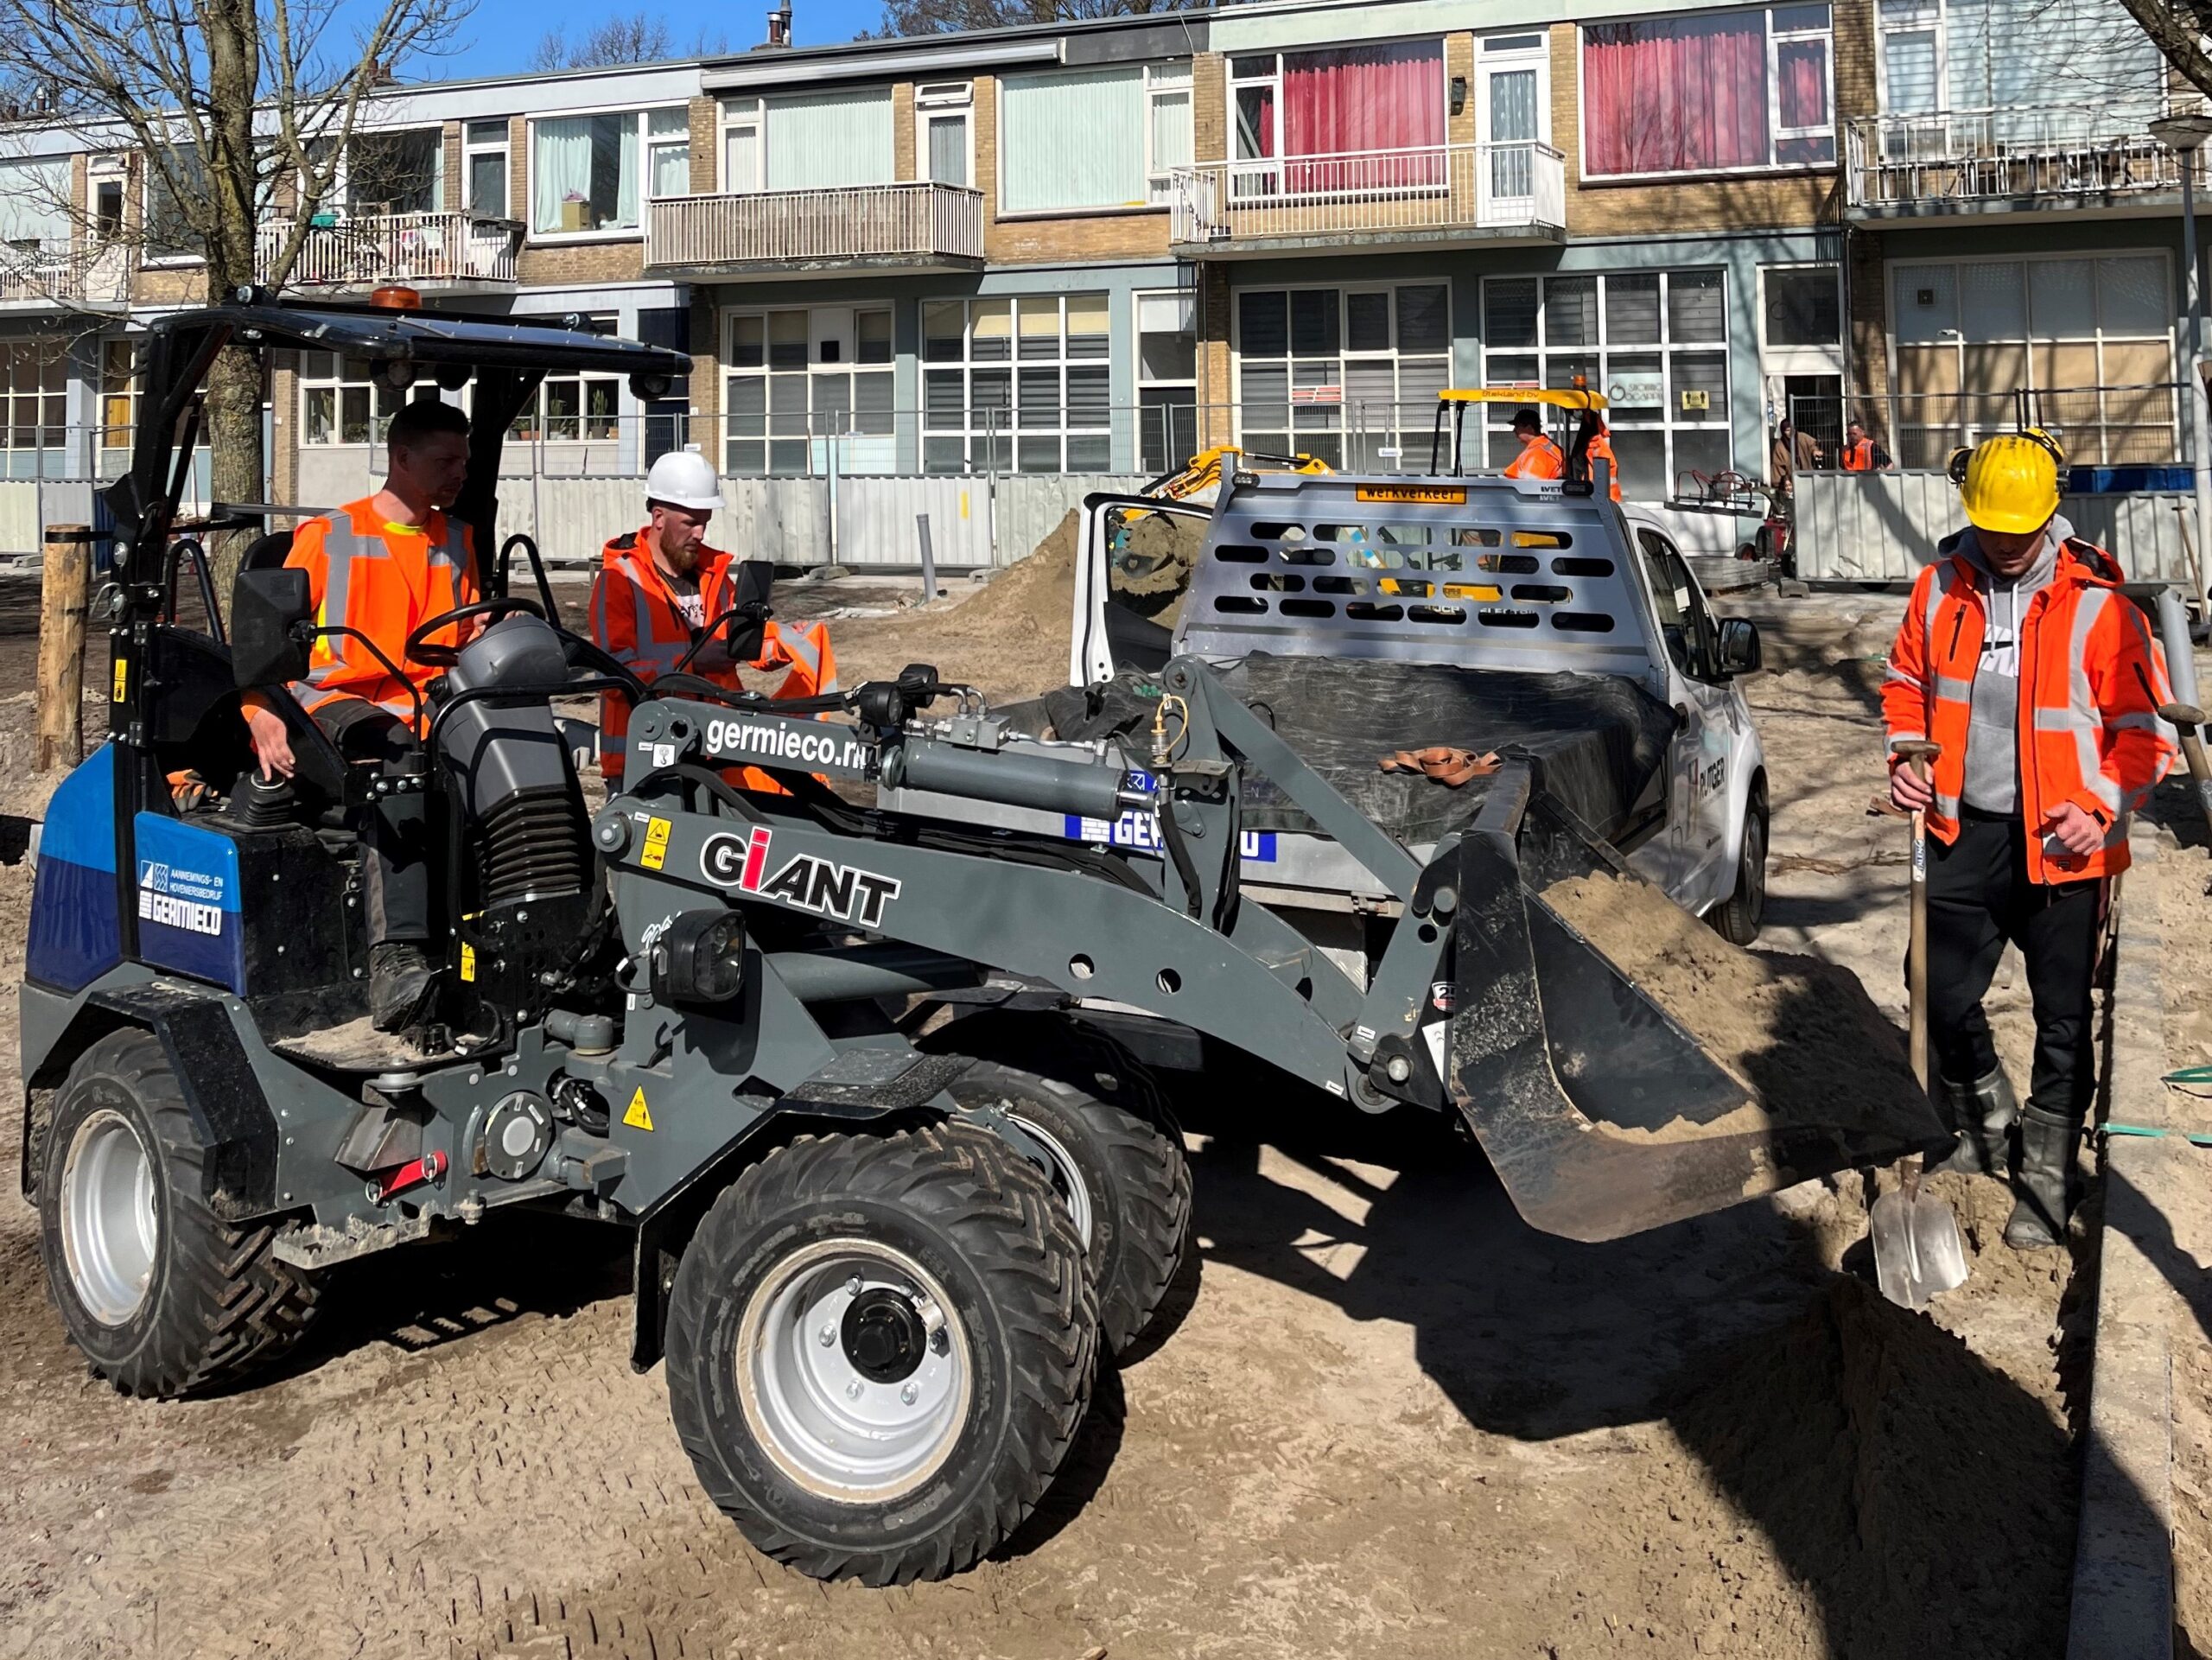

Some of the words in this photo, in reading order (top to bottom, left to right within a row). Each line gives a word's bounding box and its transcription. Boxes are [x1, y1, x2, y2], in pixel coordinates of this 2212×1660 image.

[1366, 486, 1457, 500] werkverkeer
[170, 869, 213, 886] AANNEMINGS-
[213, 876, 224, 887] EN
[169, 881, 223, 900] HOVENIERSBEDRIJF
[153, 894, 222, 937] GERMIECO
